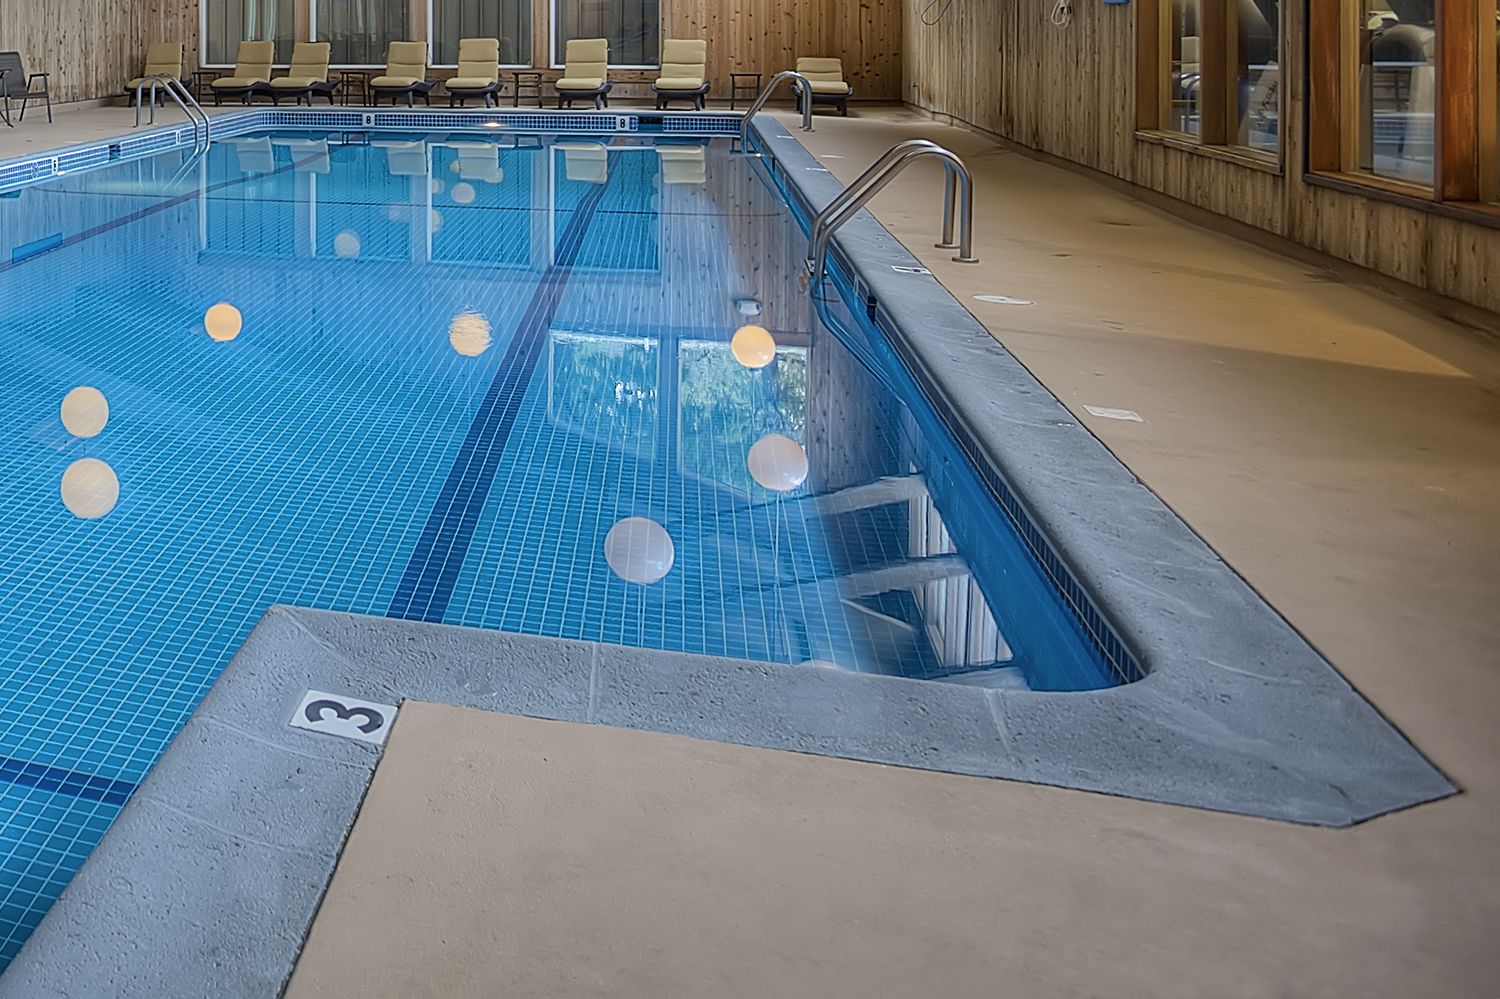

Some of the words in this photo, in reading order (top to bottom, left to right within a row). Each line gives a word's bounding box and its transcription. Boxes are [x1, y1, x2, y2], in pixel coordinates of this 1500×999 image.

[366, 115, 371, 125] 8
[620, 118, 625, 128] 8
[305, 699, 384, 734] 3
